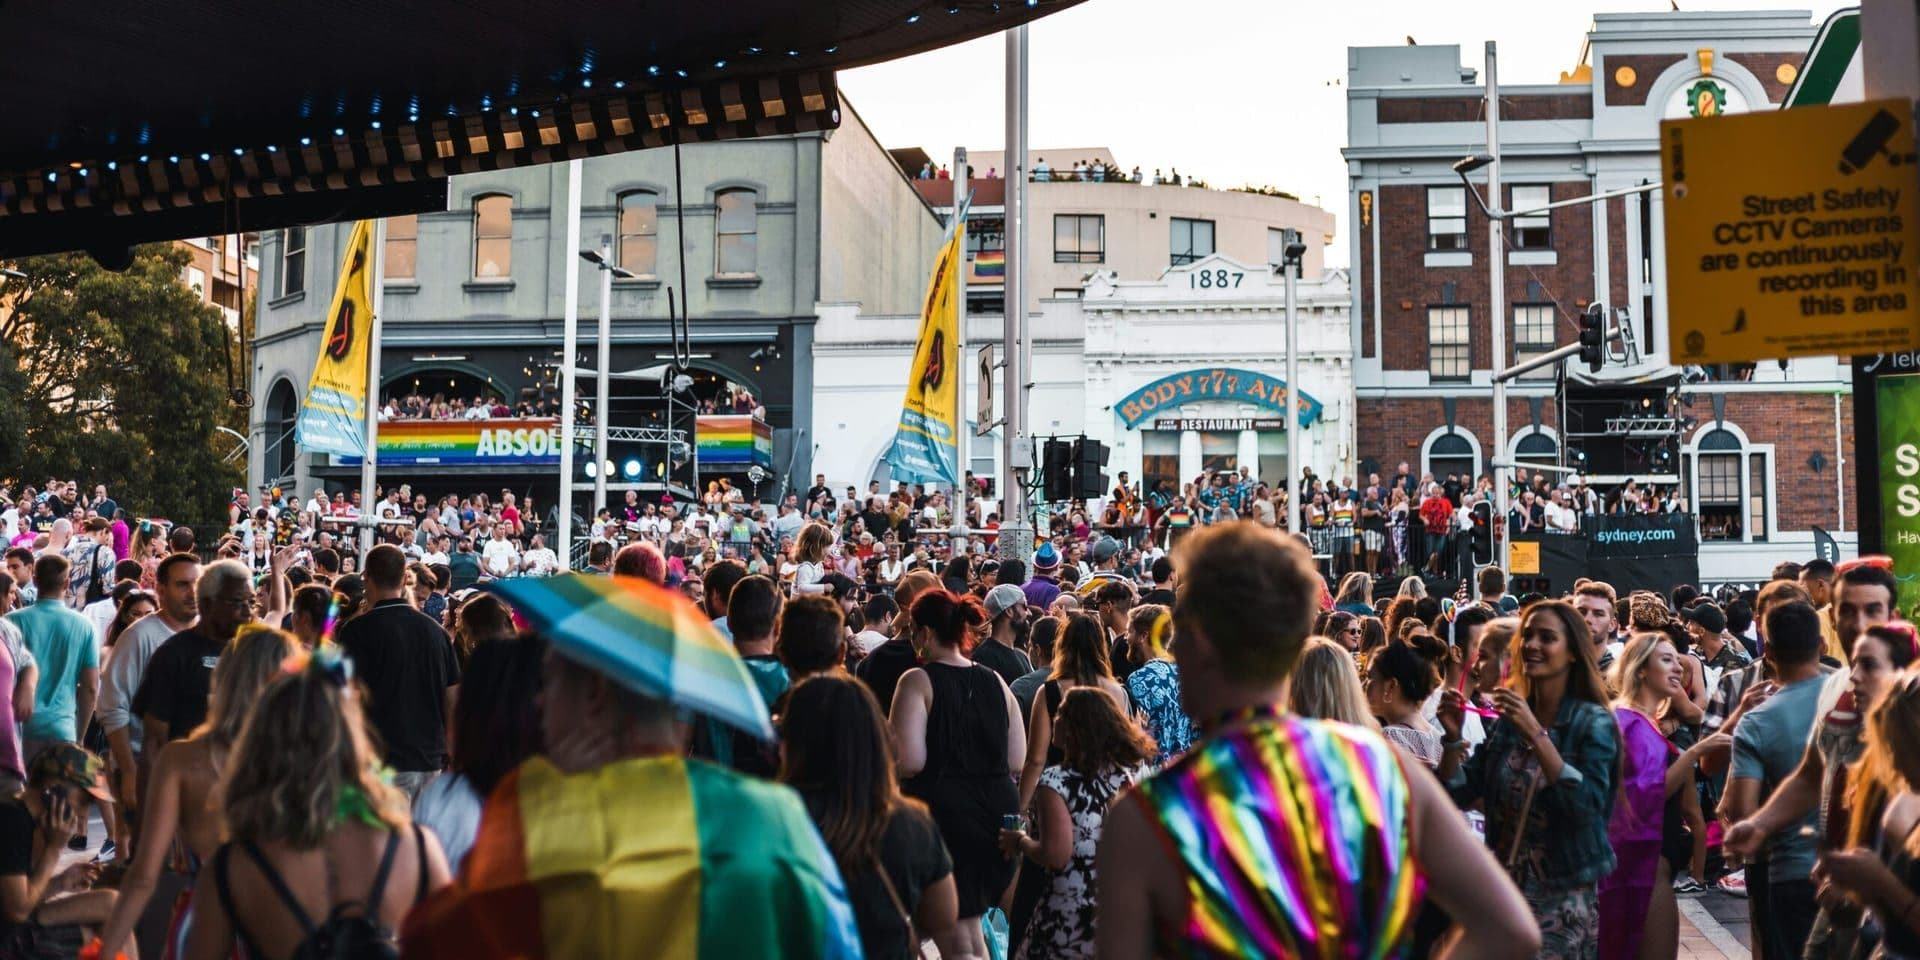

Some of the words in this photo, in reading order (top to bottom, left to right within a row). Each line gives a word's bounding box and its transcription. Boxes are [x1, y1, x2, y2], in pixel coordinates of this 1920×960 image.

[1743, 190, 1815, 217] Street
[1822, 186, 1900, 210] Safety
[1713, 219, 1784, 245] CCTV
[1791, 213, 1904, 239] Cameras
[1700, 253, 1739, 272] are
[1746, 237, 1904, 269] continuously
[1190, 269, 1244, 290] 1887
[1759, 266, 1878, 293] recording
[1884, 262, 1907, 285] in
[1800, 294, 1846, 316] this
[1853, 290, 1908, 313] area
[1121, 376, 1193, 422] BODY
[1199, 369, 1238, 394] 777
[1180, 419, 1253, 430] RESTAURANT
[1598, 528, 1675, 544] sydney.com
